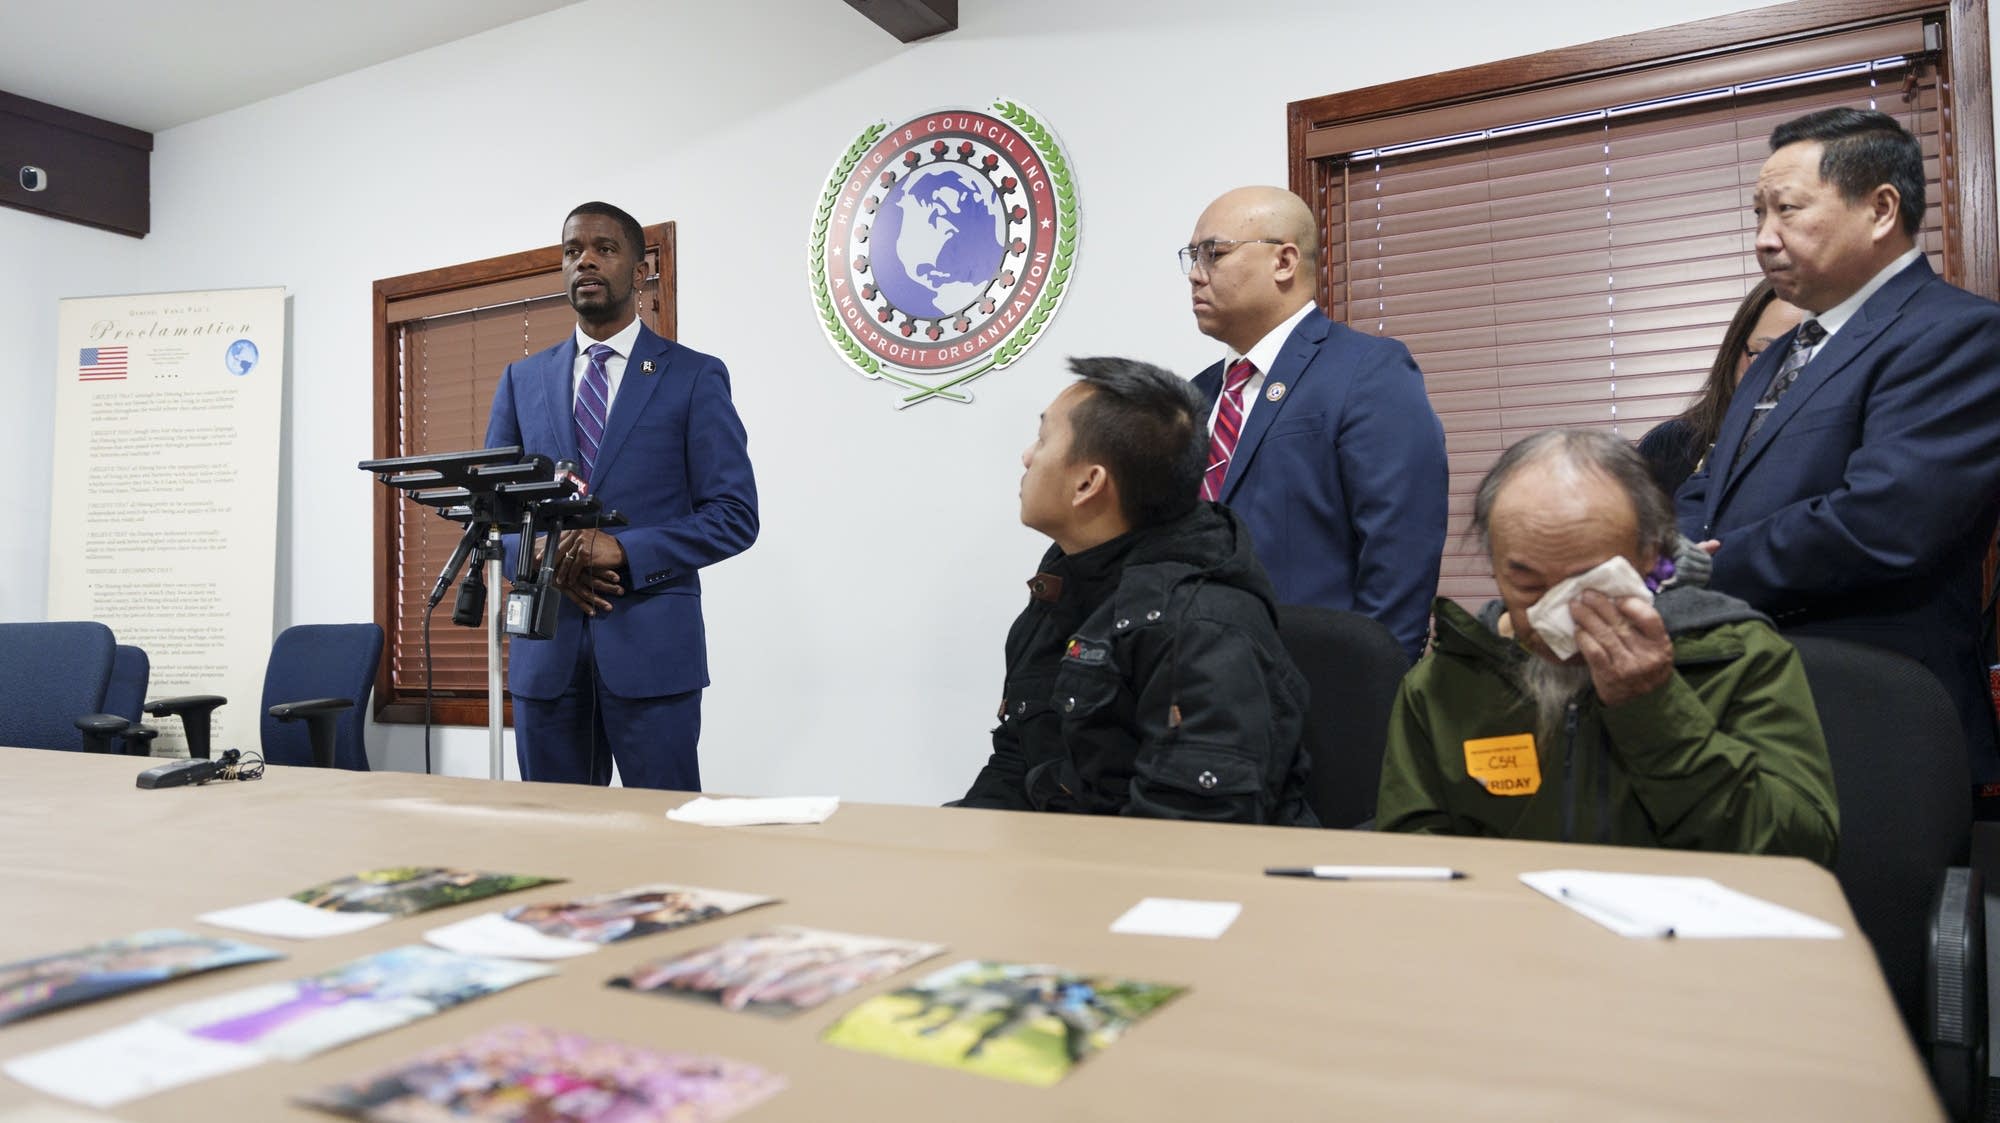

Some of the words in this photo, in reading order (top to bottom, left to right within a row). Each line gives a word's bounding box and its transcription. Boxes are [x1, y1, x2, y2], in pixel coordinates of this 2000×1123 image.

[839, 152, 883, 225] HMONG
[893, 130, 913, 147] 18
[927, 118, 1016, 152] COUNCIL
[90, 320, 251, 341] Proclamation
[834, 277, 845, 288] A
[841, 296, 928, 361] NON-PROFIT
[938, 251, 1047, 361] ORGANIZATION
[1490, 778, 1531, 790] RIDAY
